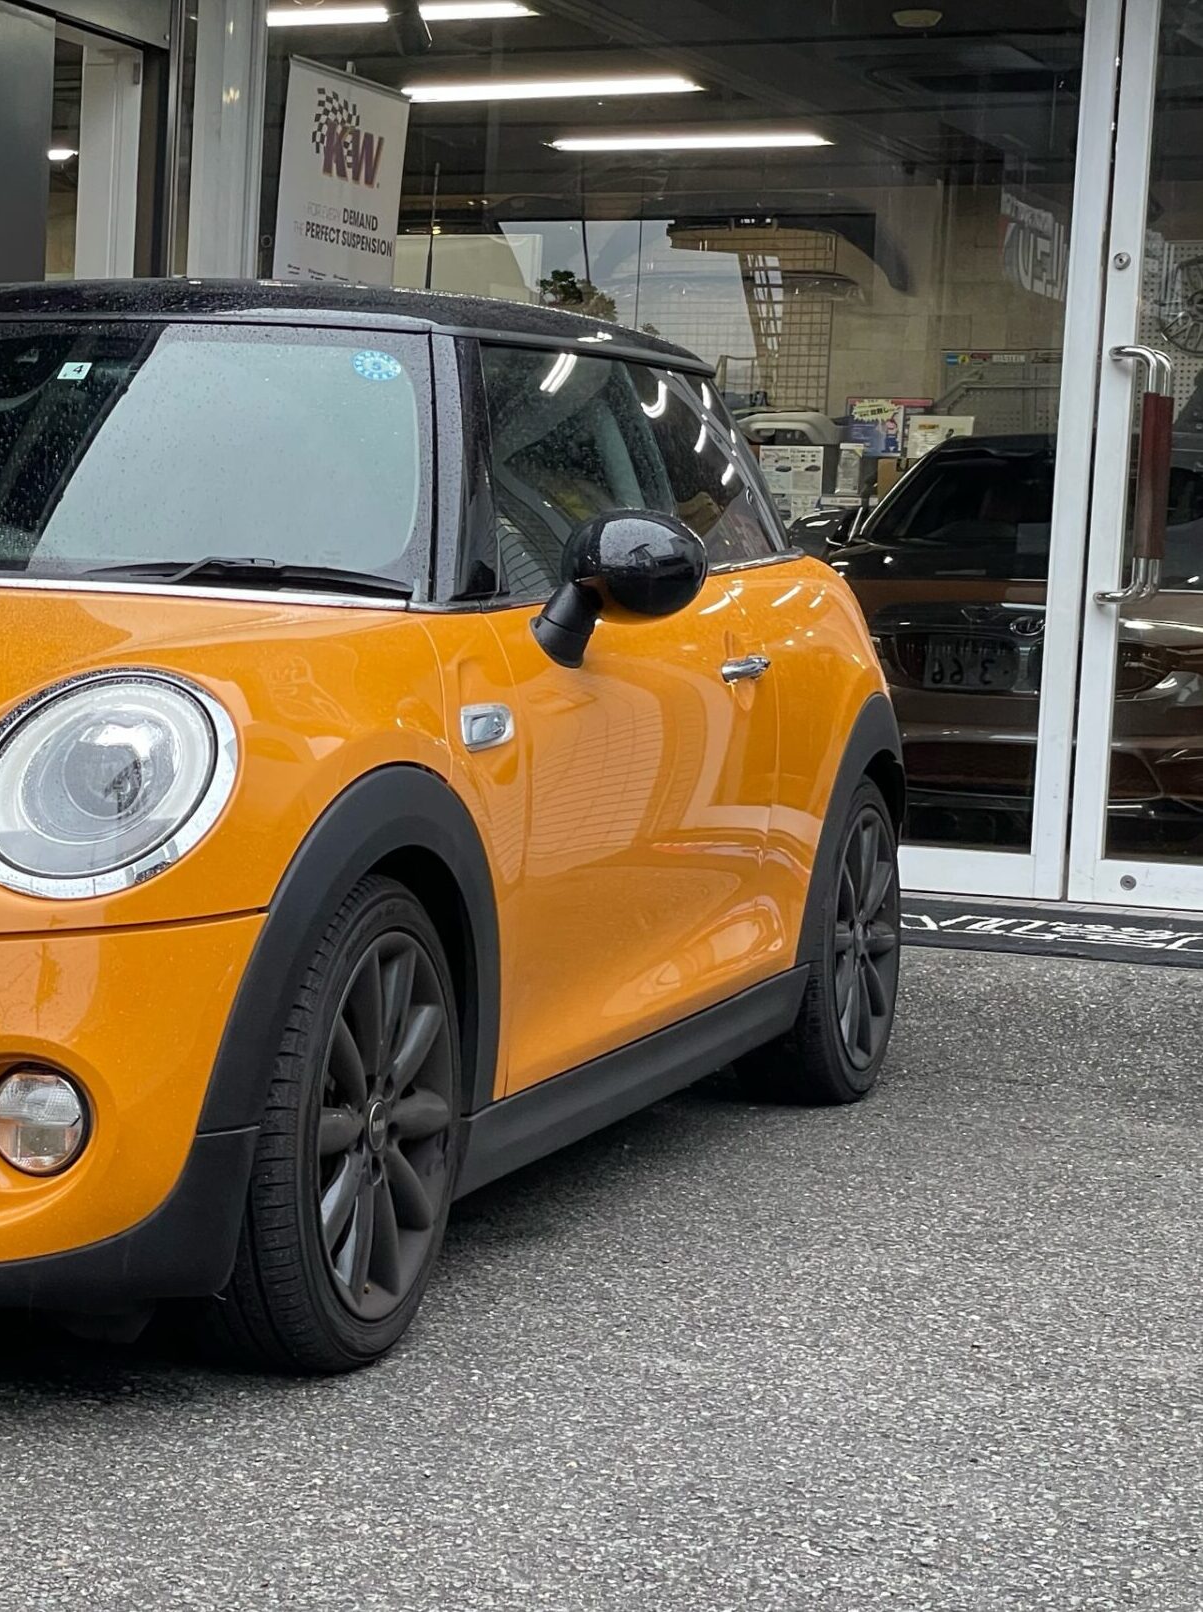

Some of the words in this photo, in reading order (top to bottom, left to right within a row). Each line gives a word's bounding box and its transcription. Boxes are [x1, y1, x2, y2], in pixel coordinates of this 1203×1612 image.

[323, 119, 384, 189] KW
[342, 208, 378, 231] DEMAND
[305, 221, 341, 245] PERFECT
[341, 230, 392, 257] SUSPENSION
[73, 365, 84, 374] 4
